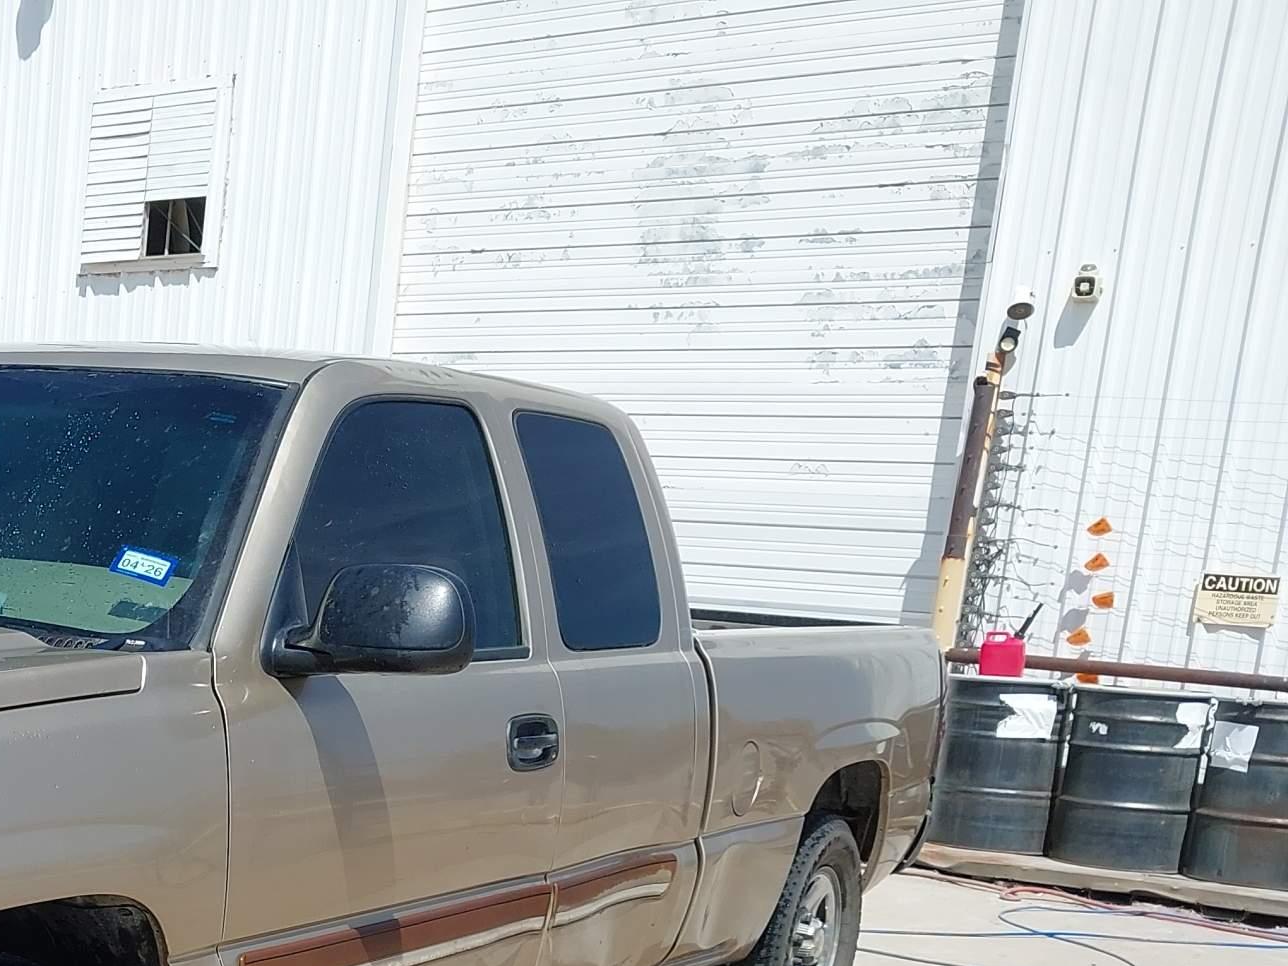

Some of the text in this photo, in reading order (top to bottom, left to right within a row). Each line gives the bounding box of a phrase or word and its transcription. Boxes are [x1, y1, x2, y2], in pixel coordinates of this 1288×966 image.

[121, 558, 139, 570] 04
[144, 564, 163, 577] 26
[1204, 575, 1278, 593] CAUTION
